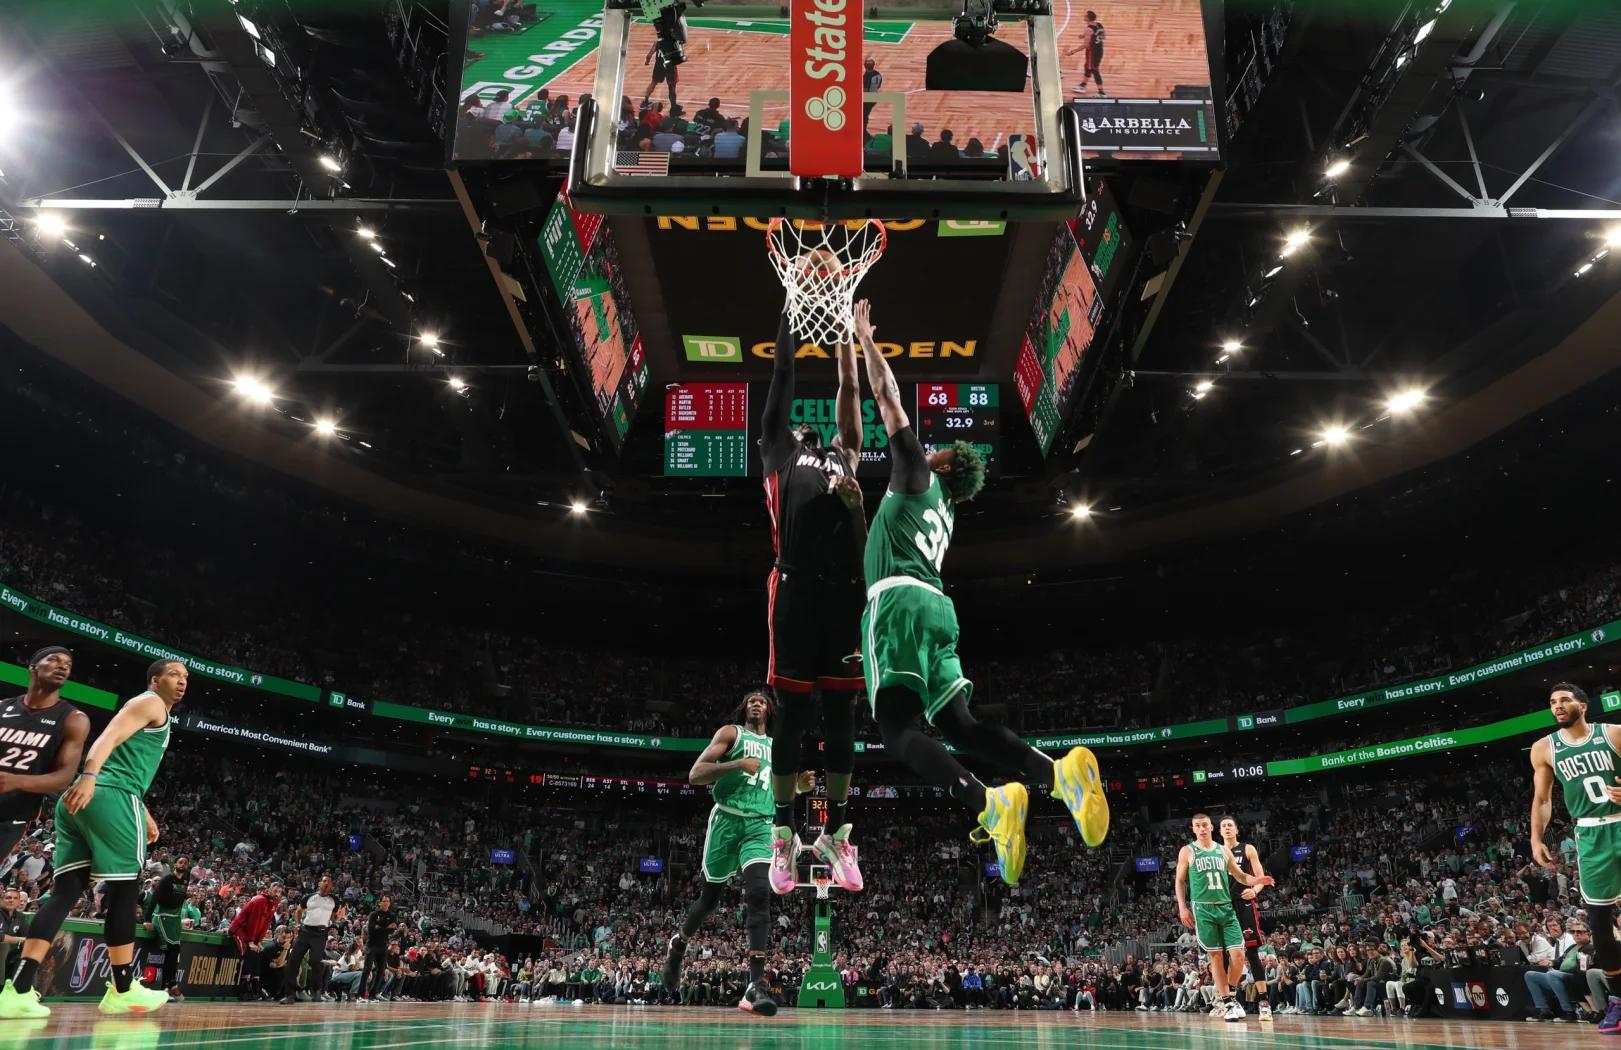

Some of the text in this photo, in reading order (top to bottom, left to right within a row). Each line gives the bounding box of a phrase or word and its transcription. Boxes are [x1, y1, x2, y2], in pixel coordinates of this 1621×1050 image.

[1098, 117, 1191, 129] ARBELLA
[689, 340, 735, 358] TD
[928, 393, 989, 406] 68 88
[945, 418, 974, 428] 32.9
[1, 588, 28, 611] Every
[48, 609, 70, 625] has
[71, 620, 79, 629] a
[80, 623, 109, 639] story.
[115, 632, 144, 651] Every
[144, 645, 189, 666] customer
[189, 658, 205, 671] has
[206, 665, 214, 674] a
[215, 667, 244, 682] story.
[1337, 697, 1365, 710] Every
[1385, 690, 1405, 700] has
[1406, 687, 1413, 695] a
[1414, 681, 1445, 693] story.
[1449, 671, 1475, 686] Every
[1477, 656, 1523, 678] customer
[1524, 650, 1544, 663] has
[1545, 647, 1553, 656] a
[1553, 637, 1586, 654] story.
[331, 692, 366, 710] TD Bank
[1603, 695, 1620, 708] TD
[428, 712, 455, 725] Every
[473, 719, 490, 729] has
[497, 724, 522, 735] story.
[526, 727, 552, 739] Every
[553, 731, 595, 742] customer
[596, 734, 612, 744] has
[621, 736, 646, 747] story.
[1239, 715, 1277, 727] TD Bank
[197, 720, 240, 737] America's
[240, 729, 261, 741] Most
[262, 733, 308, 751] Convenient
[1036, 731, 1156, 749] Every customer has a story.
[0, 747, 38, 770] 22
[1321, 737, 1456, 767] Bank of the Boston Celtics.
[1231, 765, 1263, 778] 10:06
[1556, 750, 1615, 782] BOSTON
[1195, 771, 1224, 781] TD Bank
[1583, 775, 1610, 804] 0
[1195, 856, 1225, 872] BOSTON
[1206, 871, 1224, 890] 11
[187, 955, 245, 986] BEGIN JUNE 1
